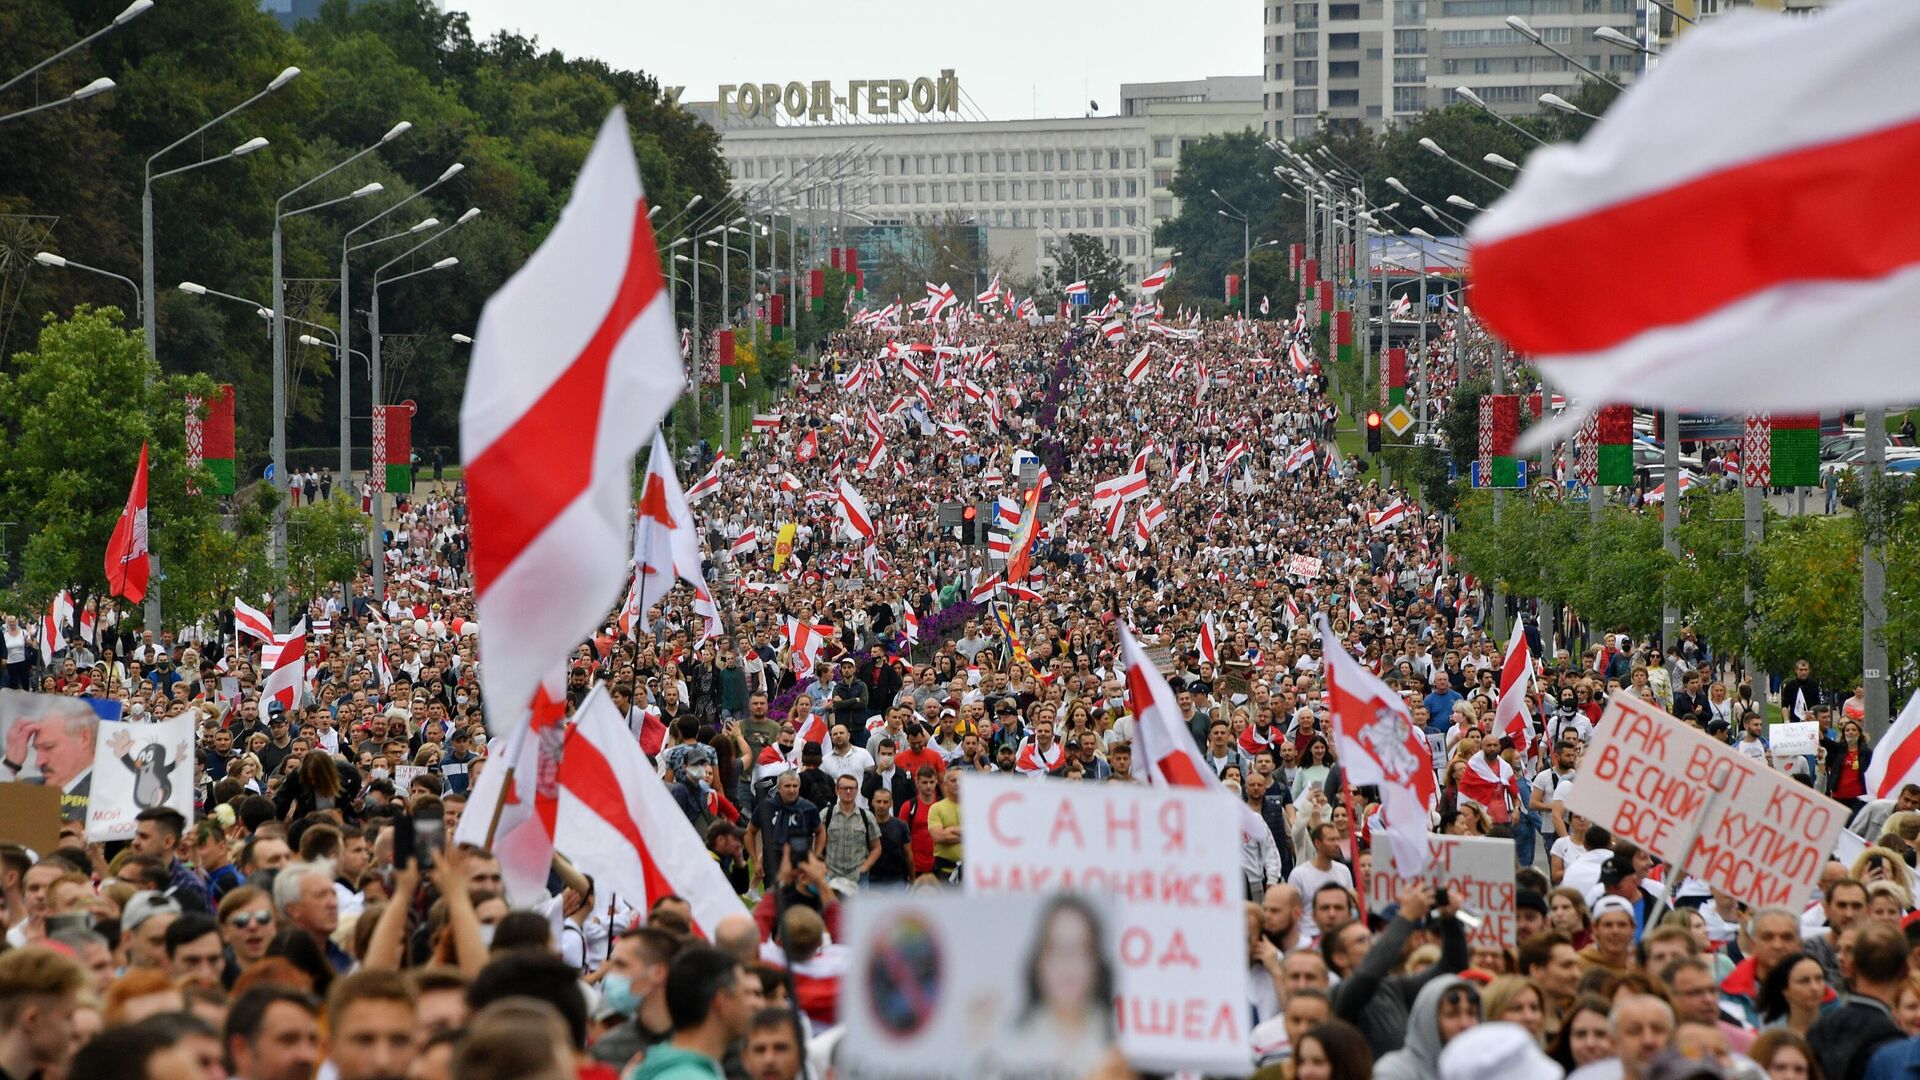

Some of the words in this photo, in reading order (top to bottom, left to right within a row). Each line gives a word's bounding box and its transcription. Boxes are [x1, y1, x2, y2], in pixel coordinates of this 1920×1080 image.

[718, 69, 959, 121] ГОРОД-ГЕРОЙ
[1594, 745, 1707, 823] ВЕСНОЙ
[1716, 807, 1819, 884] КУПИЛ
[1612, 702, 1672, 761] ТАК
[1685, 744, 1755, 800] ВОТ
[1765, 785, 1830, 842] КТО
[1612, 800, 1675, 856] ВСЕ
[1683, 834, 1793, 909] МАСКИ
